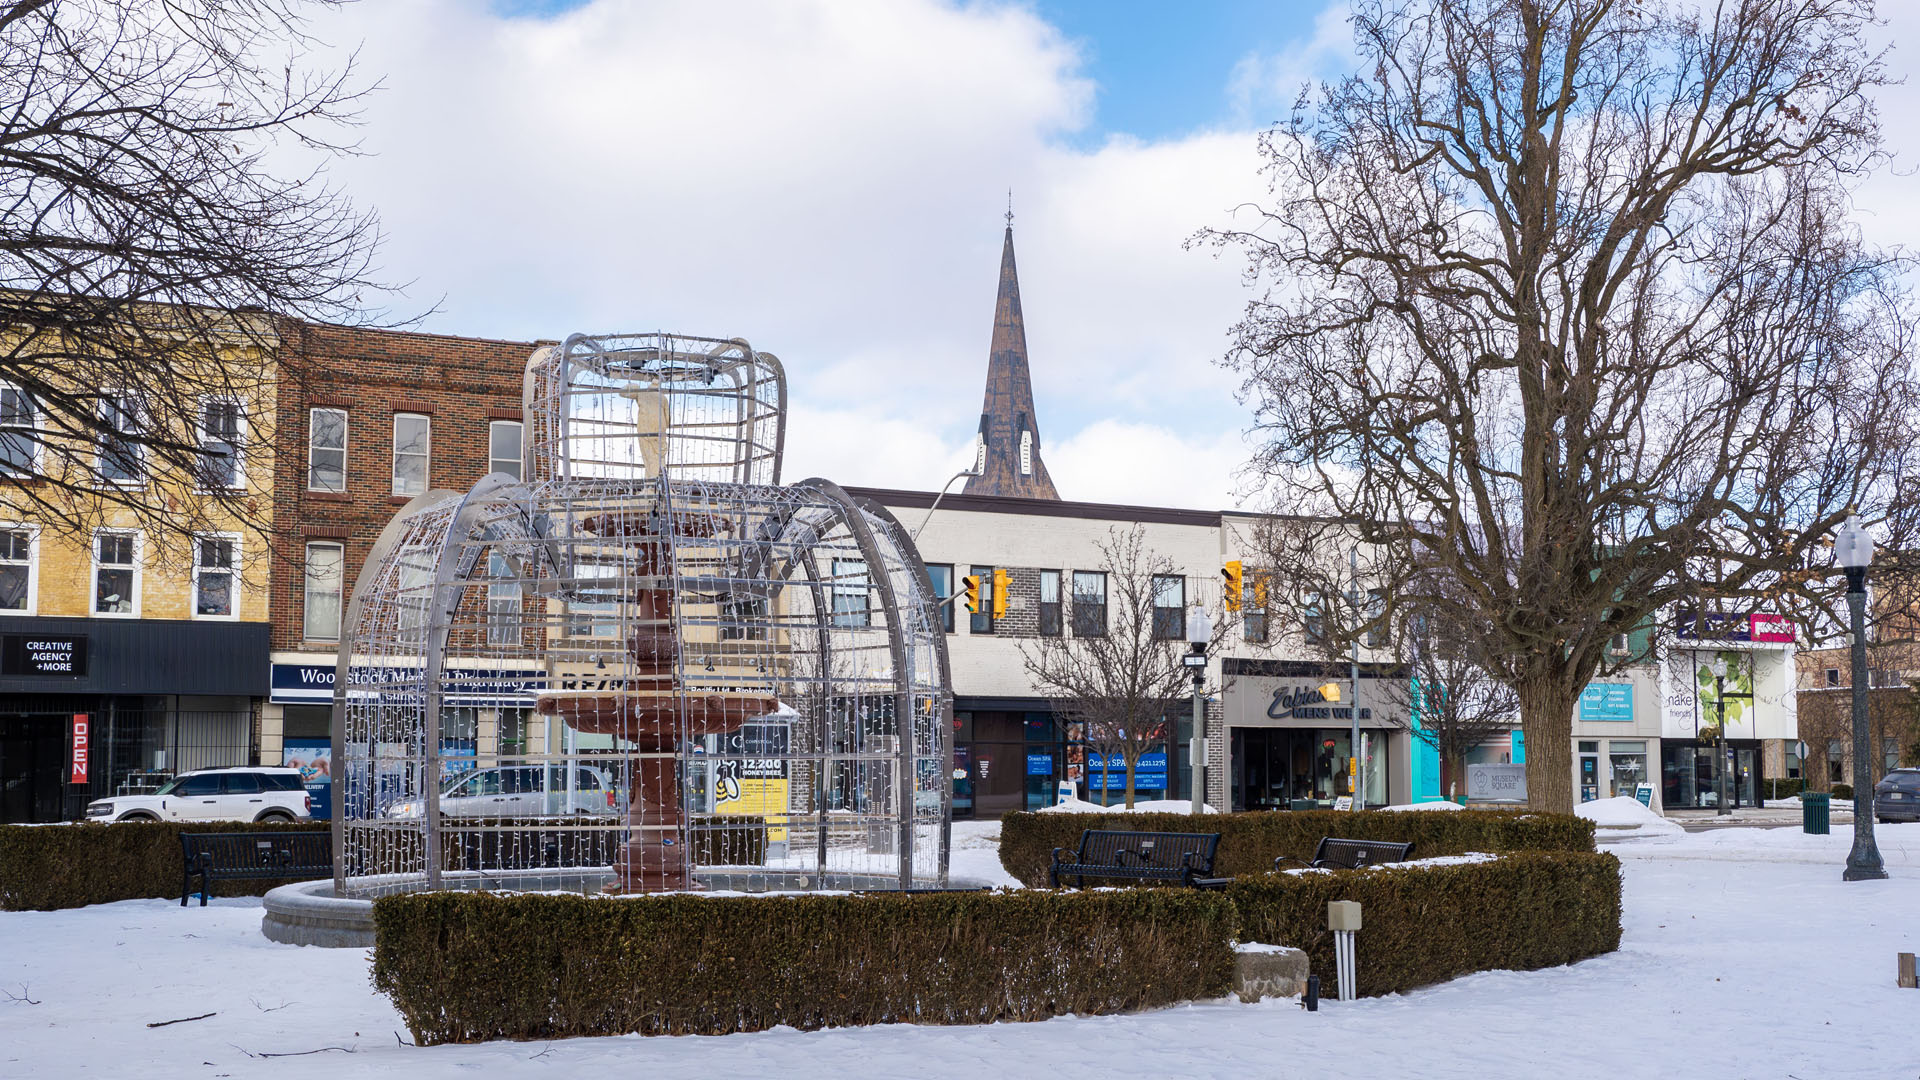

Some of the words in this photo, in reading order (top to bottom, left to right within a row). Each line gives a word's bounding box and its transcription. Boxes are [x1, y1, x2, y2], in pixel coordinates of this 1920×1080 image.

[26, 641, 73, 651] CREATIVE
[31, 652, 72, 661] AGENCY
[36, 662, 72, 671] +MORE
[300, 668, 388, 685] Woostock
[1291, 707, 1330, 719] MENS
[73, 723, 87, 775] OPEN
[1112, 759, 1127, 767] SPA
[1491, 782, 1517, 790] SQUARE
